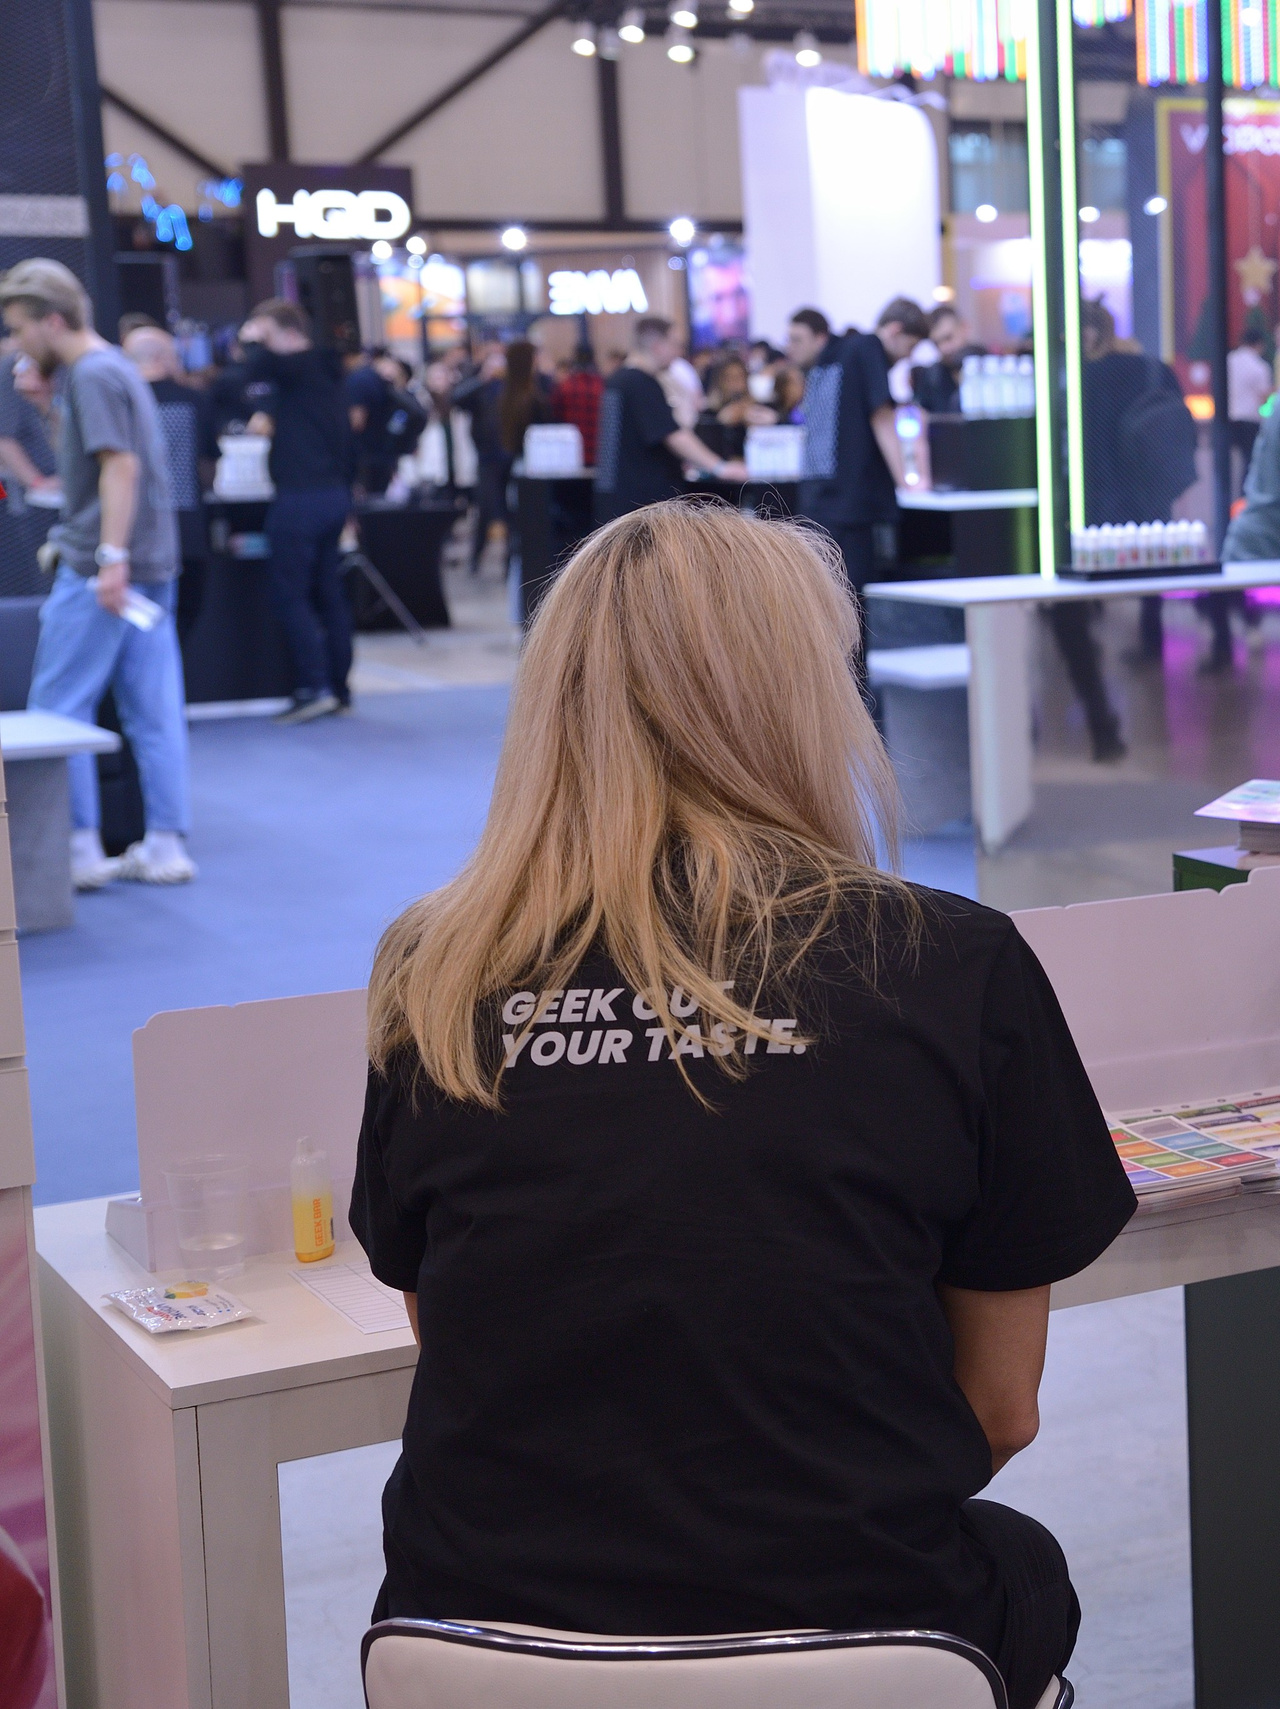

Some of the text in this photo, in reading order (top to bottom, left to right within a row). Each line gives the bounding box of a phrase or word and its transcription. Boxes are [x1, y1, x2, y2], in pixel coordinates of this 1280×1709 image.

[256, 187, 411, 240] HQD
[501, 987, 625, 1026] GEEK
[501, 1028, 633, 1069] YOUR
